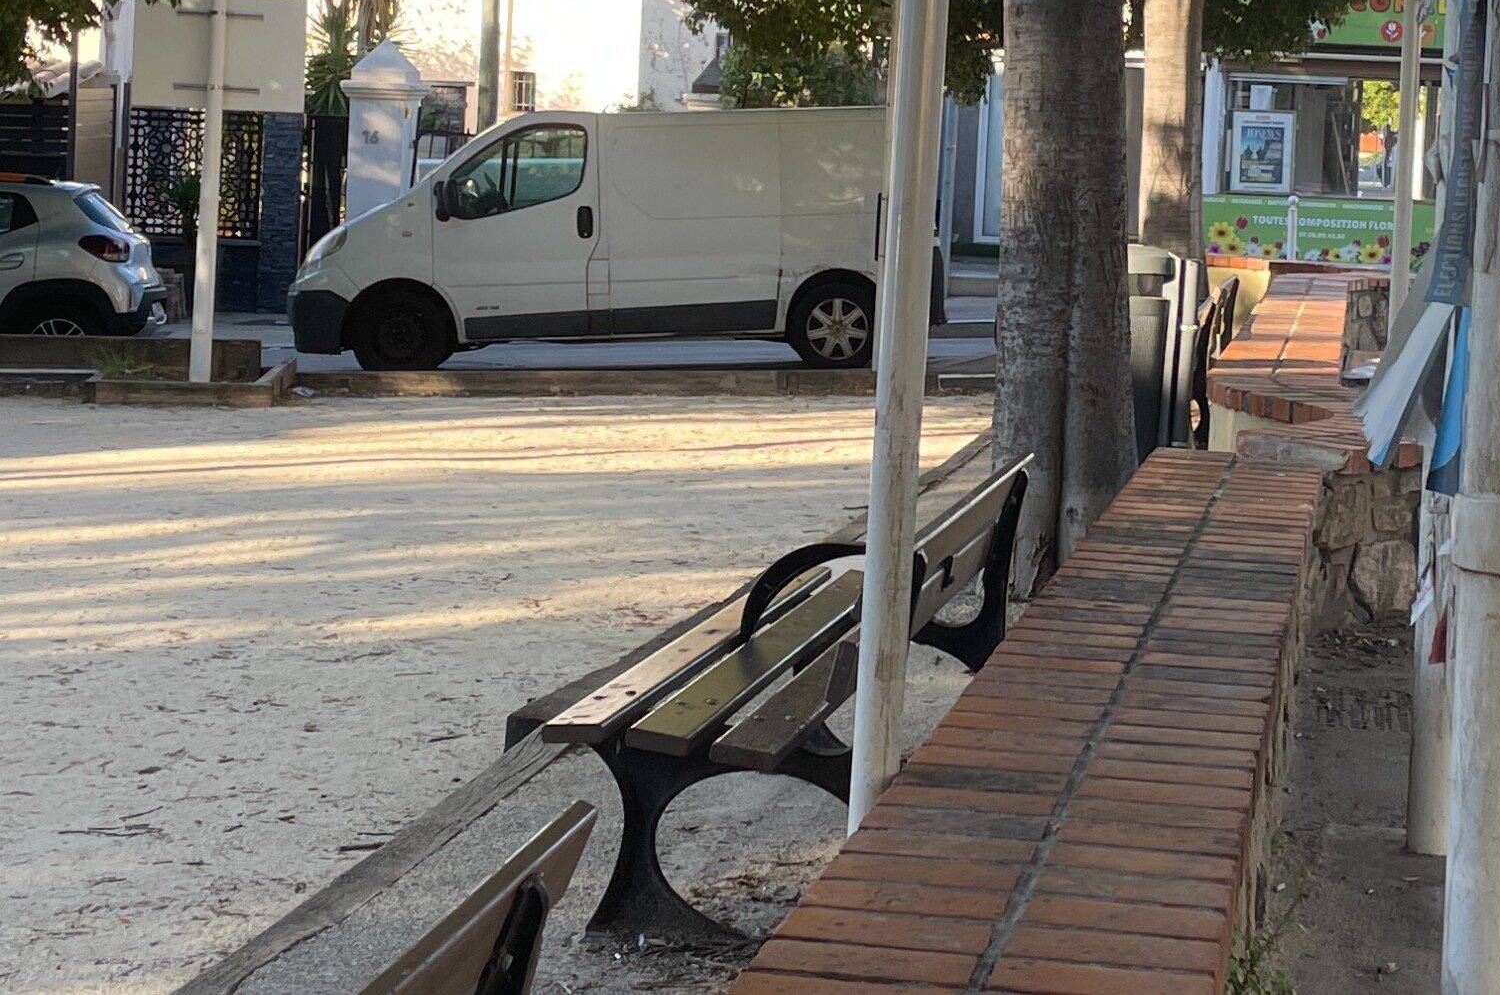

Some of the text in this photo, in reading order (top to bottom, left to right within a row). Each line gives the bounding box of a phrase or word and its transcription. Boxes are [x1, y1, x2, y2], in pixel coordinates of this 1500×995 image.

[361, 130, 380, 144] 16
[1252, 215, 1395, 232] TOUTES OMPOSITION FLOR
